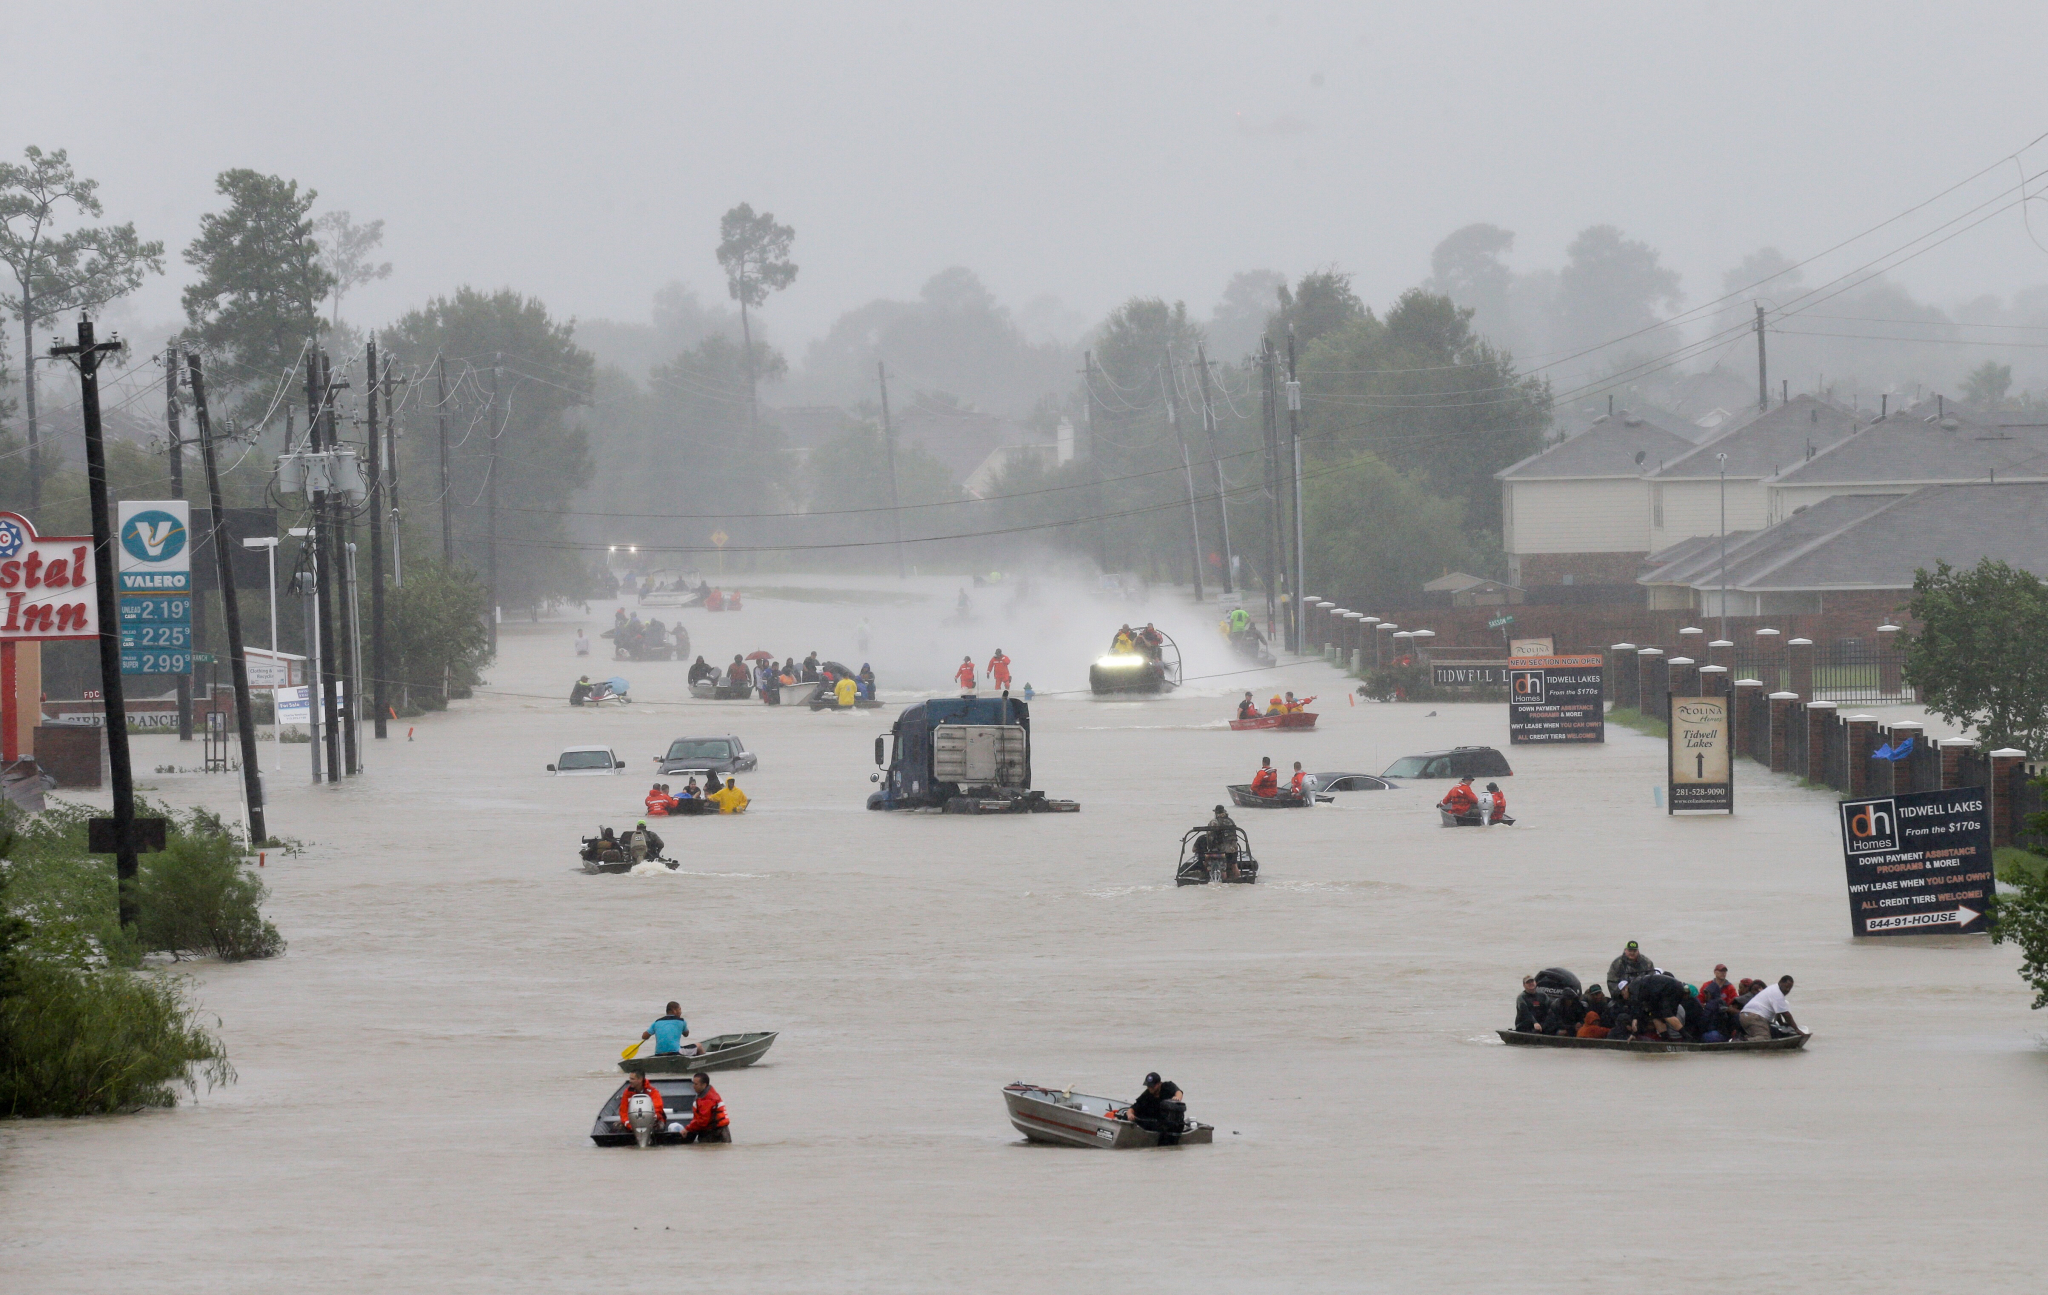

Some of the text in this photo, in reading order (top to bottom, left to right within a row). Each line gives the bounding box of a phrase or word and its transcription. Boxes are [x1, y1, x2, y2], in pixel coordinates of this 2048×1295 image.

[0, 546, 87, 588] stal
[124, 575, 186, 588] VALERO
[1, 592, 88, 632] Inn
[142, 601, 183, 618] 2.19
[142, 628, 184, 645] 2.25
[142, 655, 183, 672] 2.99
[1529, 658, 1559, 666] SECTION
[1437, 670, 1492, 682] TIDWELL
[1516, 674, 1540, 694] dh
[127, 715, 179, 727] RANCH
[1684, 730, 1717, 739] Tidwell
[1686, 739, 1713, 748] Lakes
[1676, 788, 1725, 796] 281-528-9090
[1899, 800, 1982, 818] TIDWELL LAKES
[1852, 805, 1890, 837] dh
[1906, 821, 1981, 836] From the $170s
[1854, 838, 1892, 850] Homes
[1859, 847, 1976, 865] DOWN PAYMENT ASSISTANCE
[1877, 862, 1924, 874] PROGRAMS
[1934, 858, 1960, 868] MORE!
[1850, 872, 1991, 893] WHY LEASE WHEN YOU CAN OWN?
[1862, 890, 1983, 909] ALL CREDIT TIERS WELCOME!
[1869, 912, 1957, 929] 844-91-HOUSE
[1536, 986, 1564, 994] MERCUR
